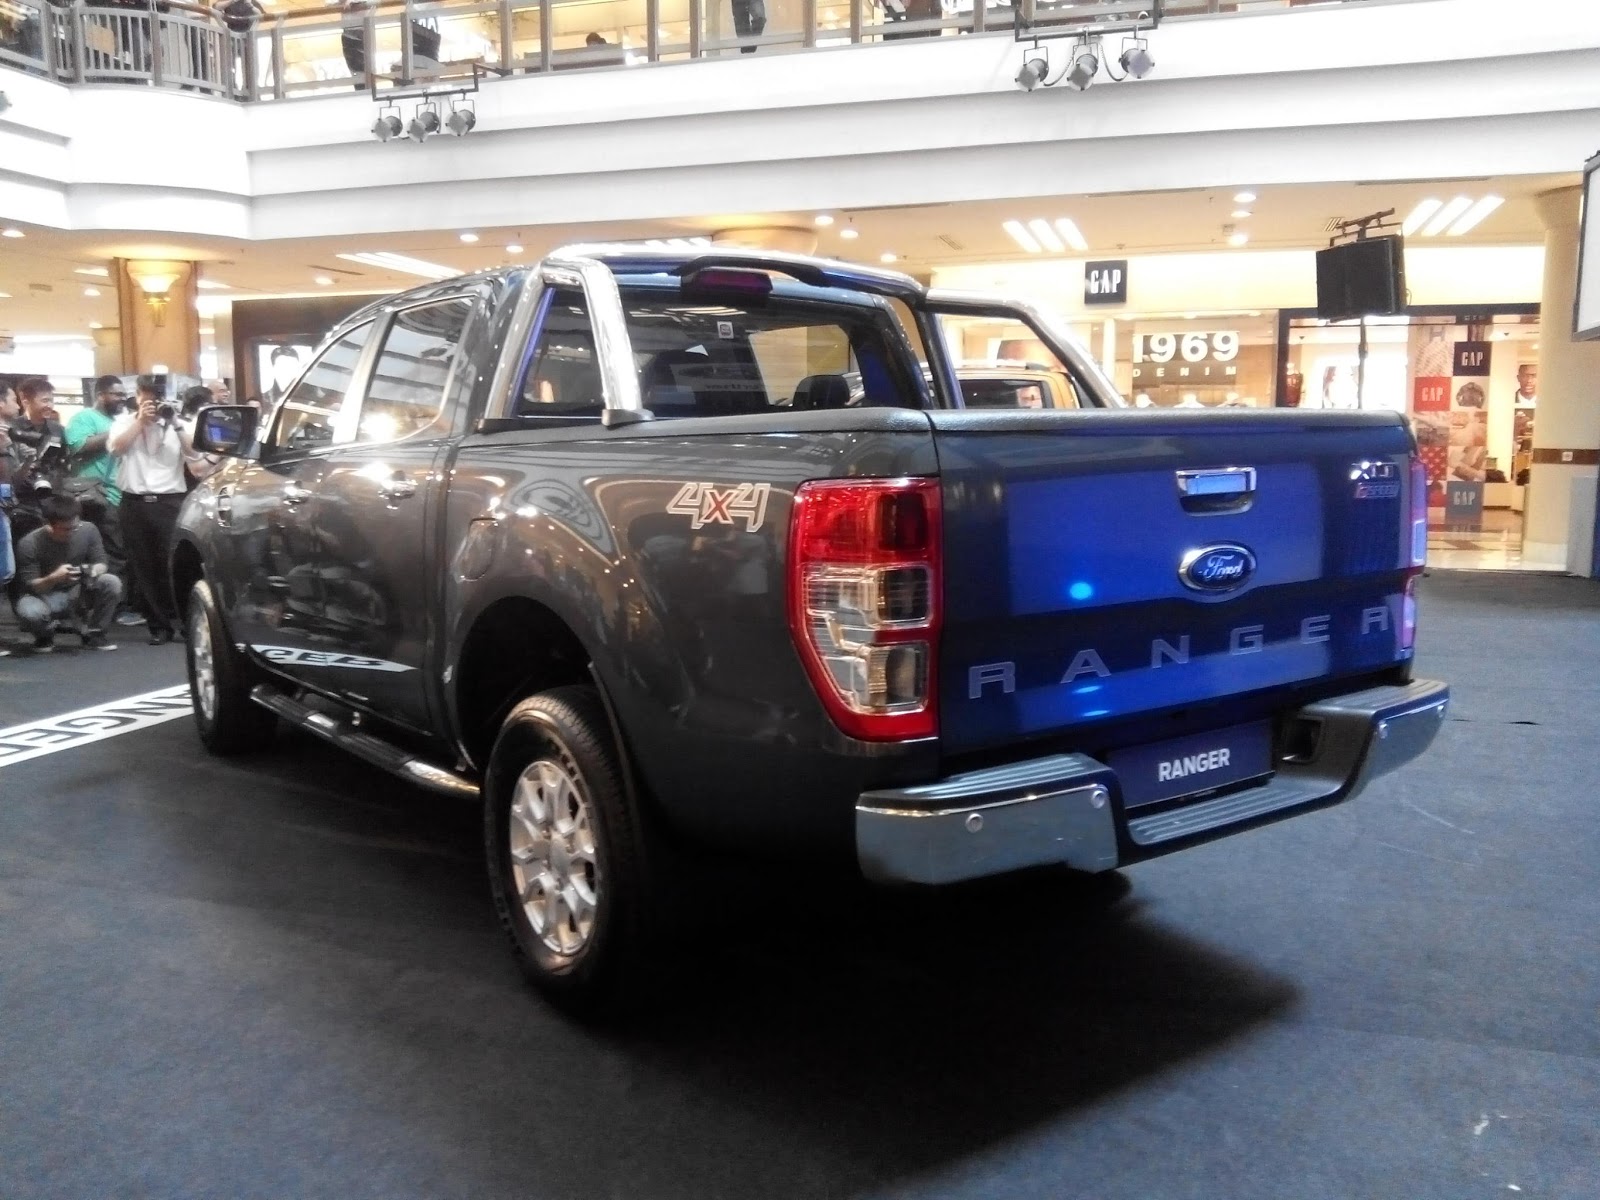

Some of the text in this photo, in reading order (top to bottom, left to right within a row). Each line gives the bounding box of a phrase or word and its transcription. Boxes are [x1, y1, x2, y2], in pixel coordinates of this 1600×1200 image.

[1090, 269, 1122, 294] GAP
[1132, 331, 1239, 363] 1969
[1461, 352, 1484, 366] GAP
[1132, 366, 1237, 378] DENIM
[1421, 387, 1444, 402] GAP
[1453, 491, 1476, 506] GAP
[1200, 555, 1244, 579] Ford
[968, 606, 1389, 699] RANGER
[1158, 748, 1230, 782] RANGER
